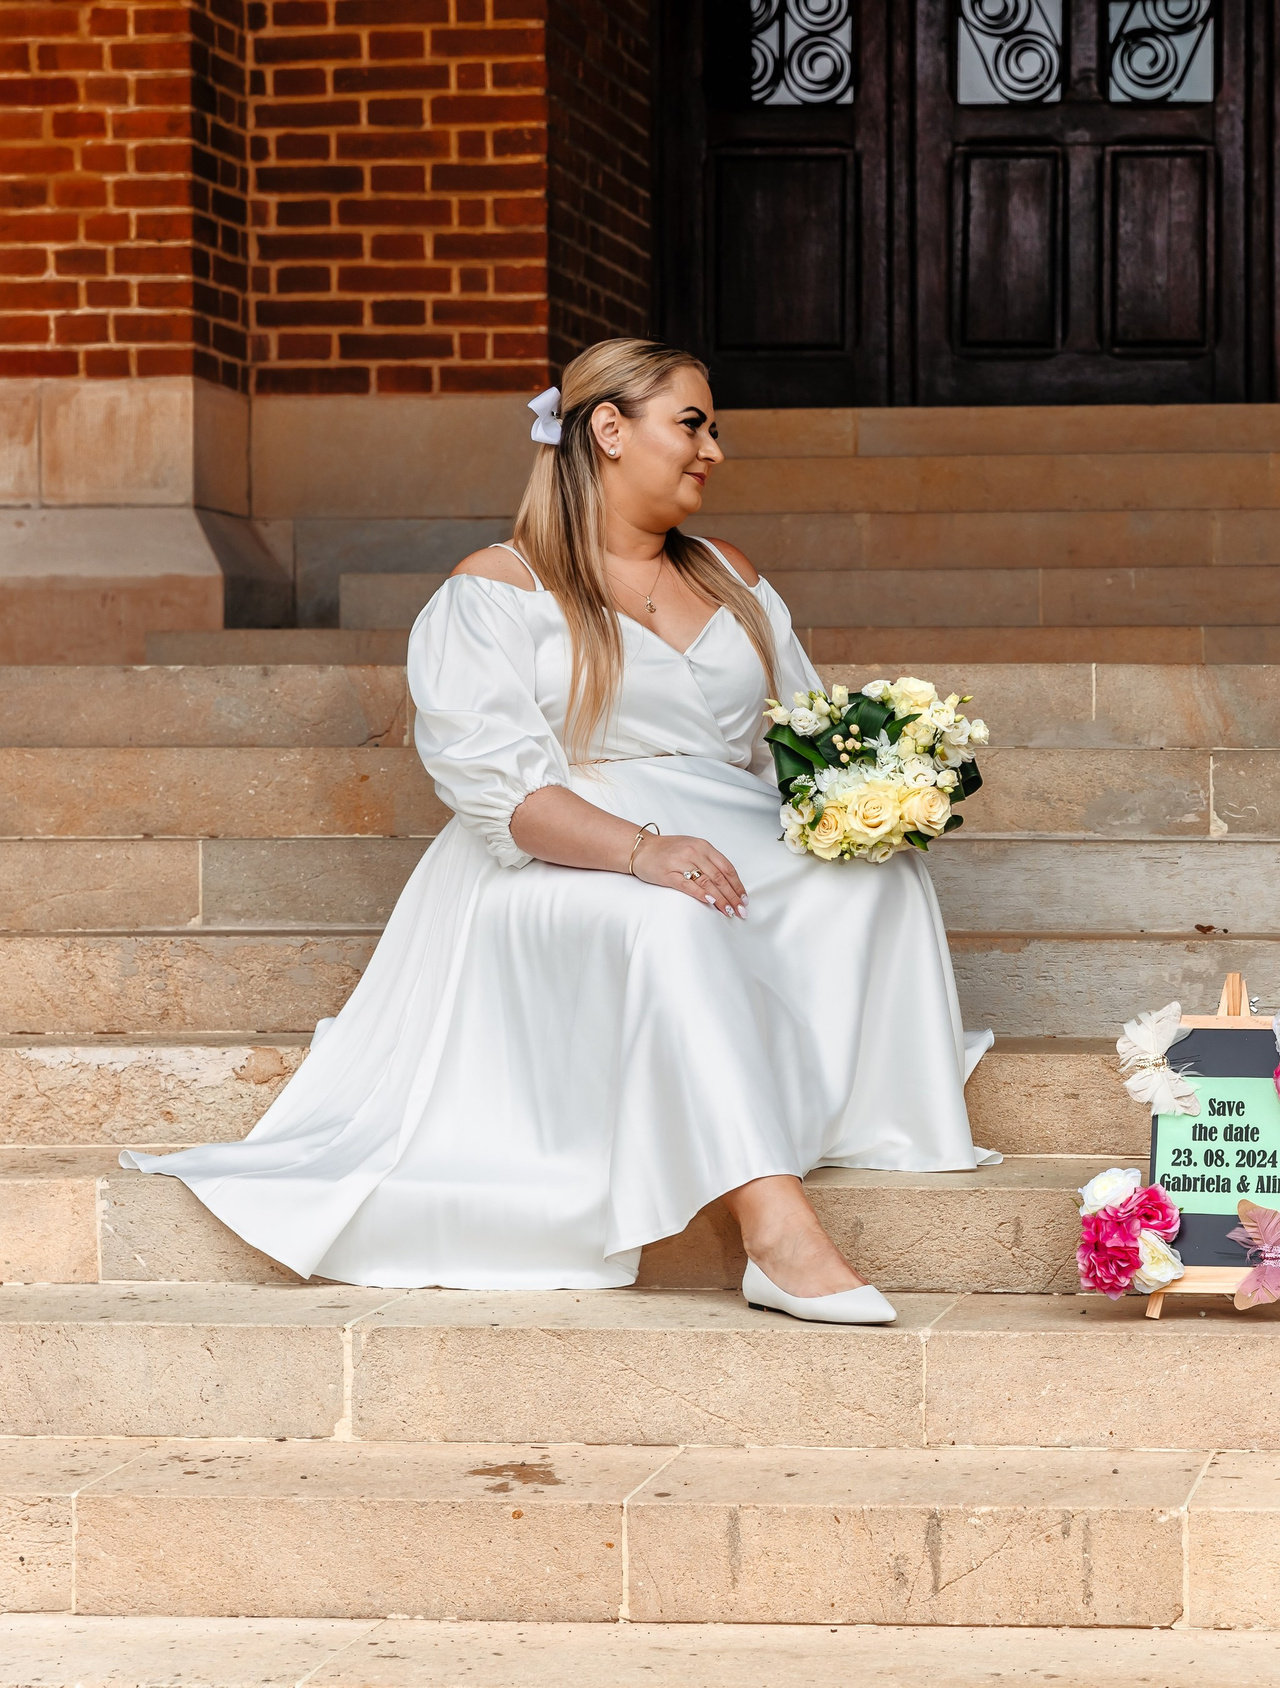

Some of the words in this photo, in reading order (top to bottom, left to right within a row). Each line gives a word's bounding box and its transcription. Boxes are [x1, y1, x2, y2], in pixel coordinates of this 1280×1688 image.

[1208, 1098, 1246, 1117] Save
[1191, 1123, 1218, 1142] the
[1223, 1123, 1260, 1142] date
[1171, 1148, 1198, 1168] 23.
[1203, 1148, 1230, 1168] 08.
[1235, 1149, 1278, 1169] 2024
[1159, 1173, 1232, 1194] Gabriela
[1236, 1174, 1251, 1194] &
